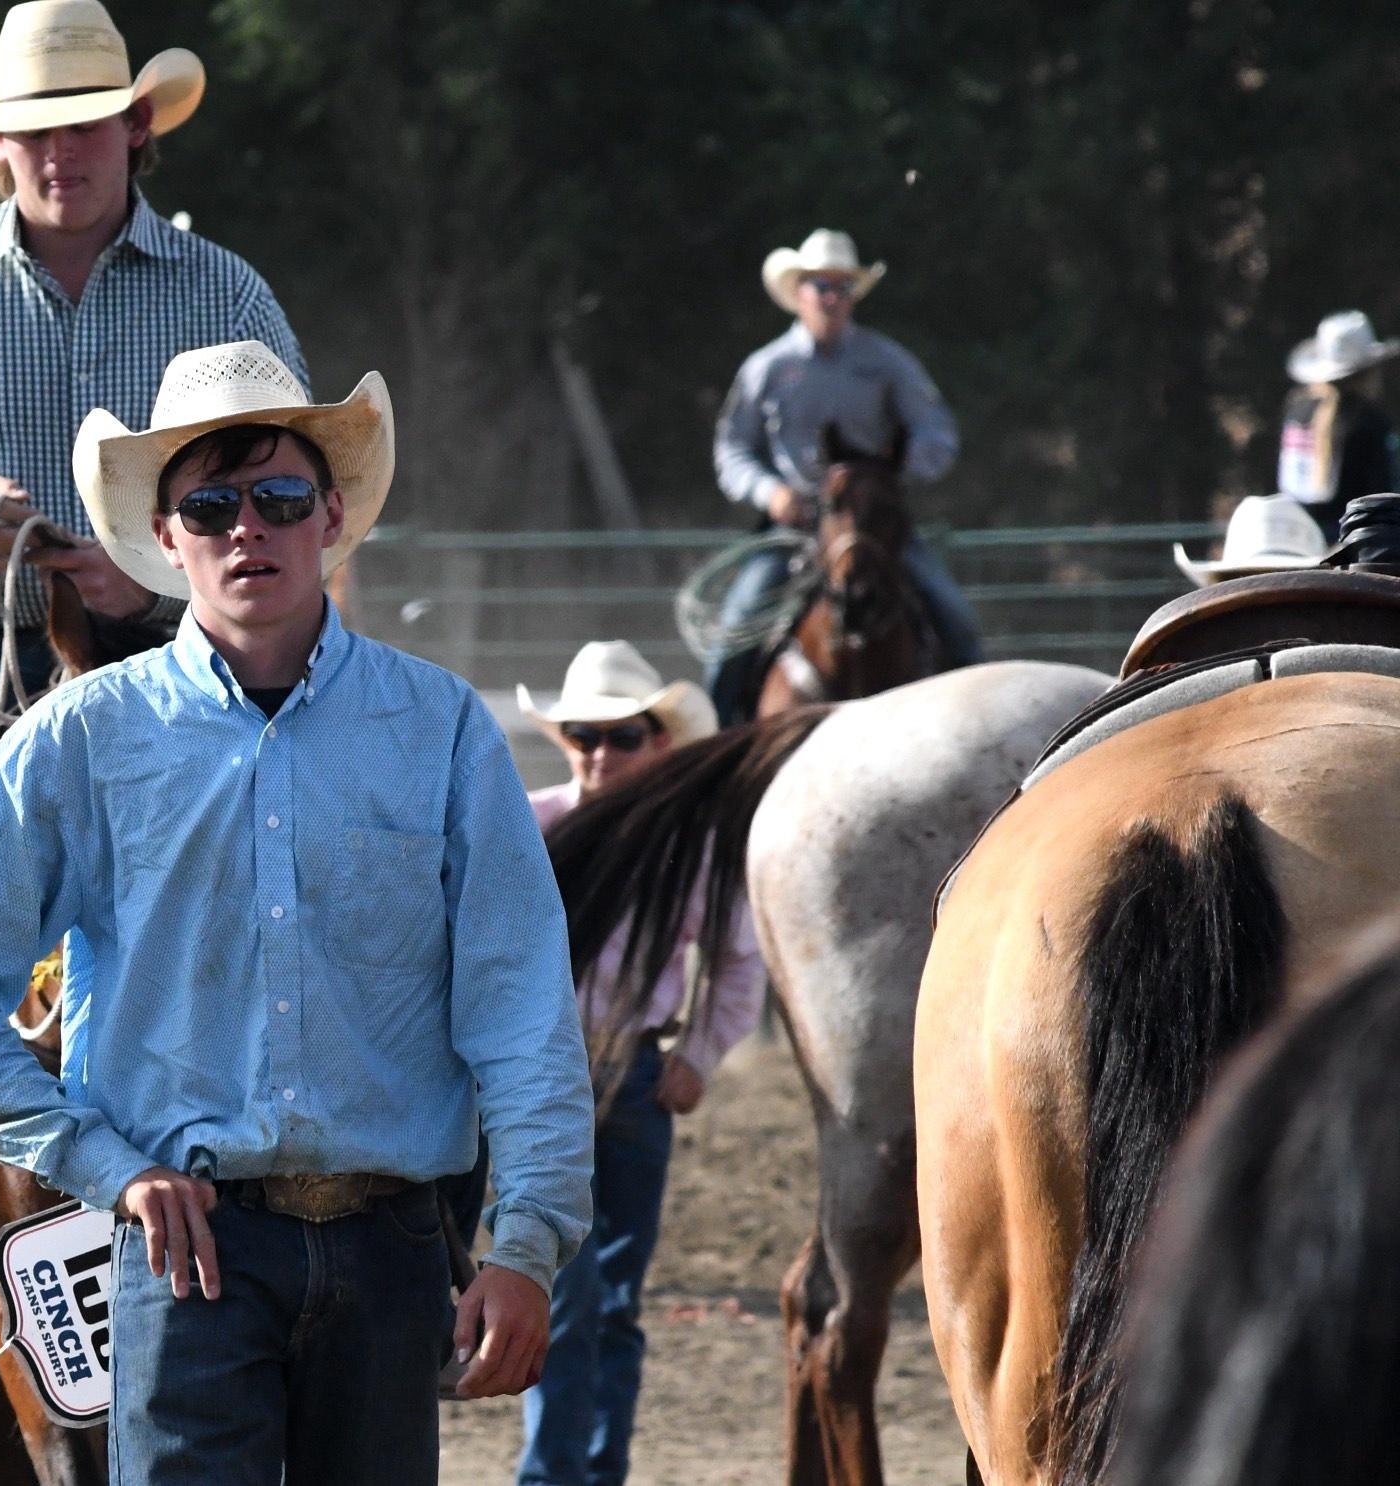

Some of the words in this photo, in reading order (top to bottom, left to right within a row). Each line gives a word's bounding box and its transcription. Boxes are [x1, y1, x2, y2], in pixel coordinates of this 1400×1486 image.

[16, 1267, 43, 1316] JEANS
[37, 1318, 47, 1332] &
[42, 1332, 68, 1387] SHIRTS
[33, 1259, 93, 1383] CINCH
